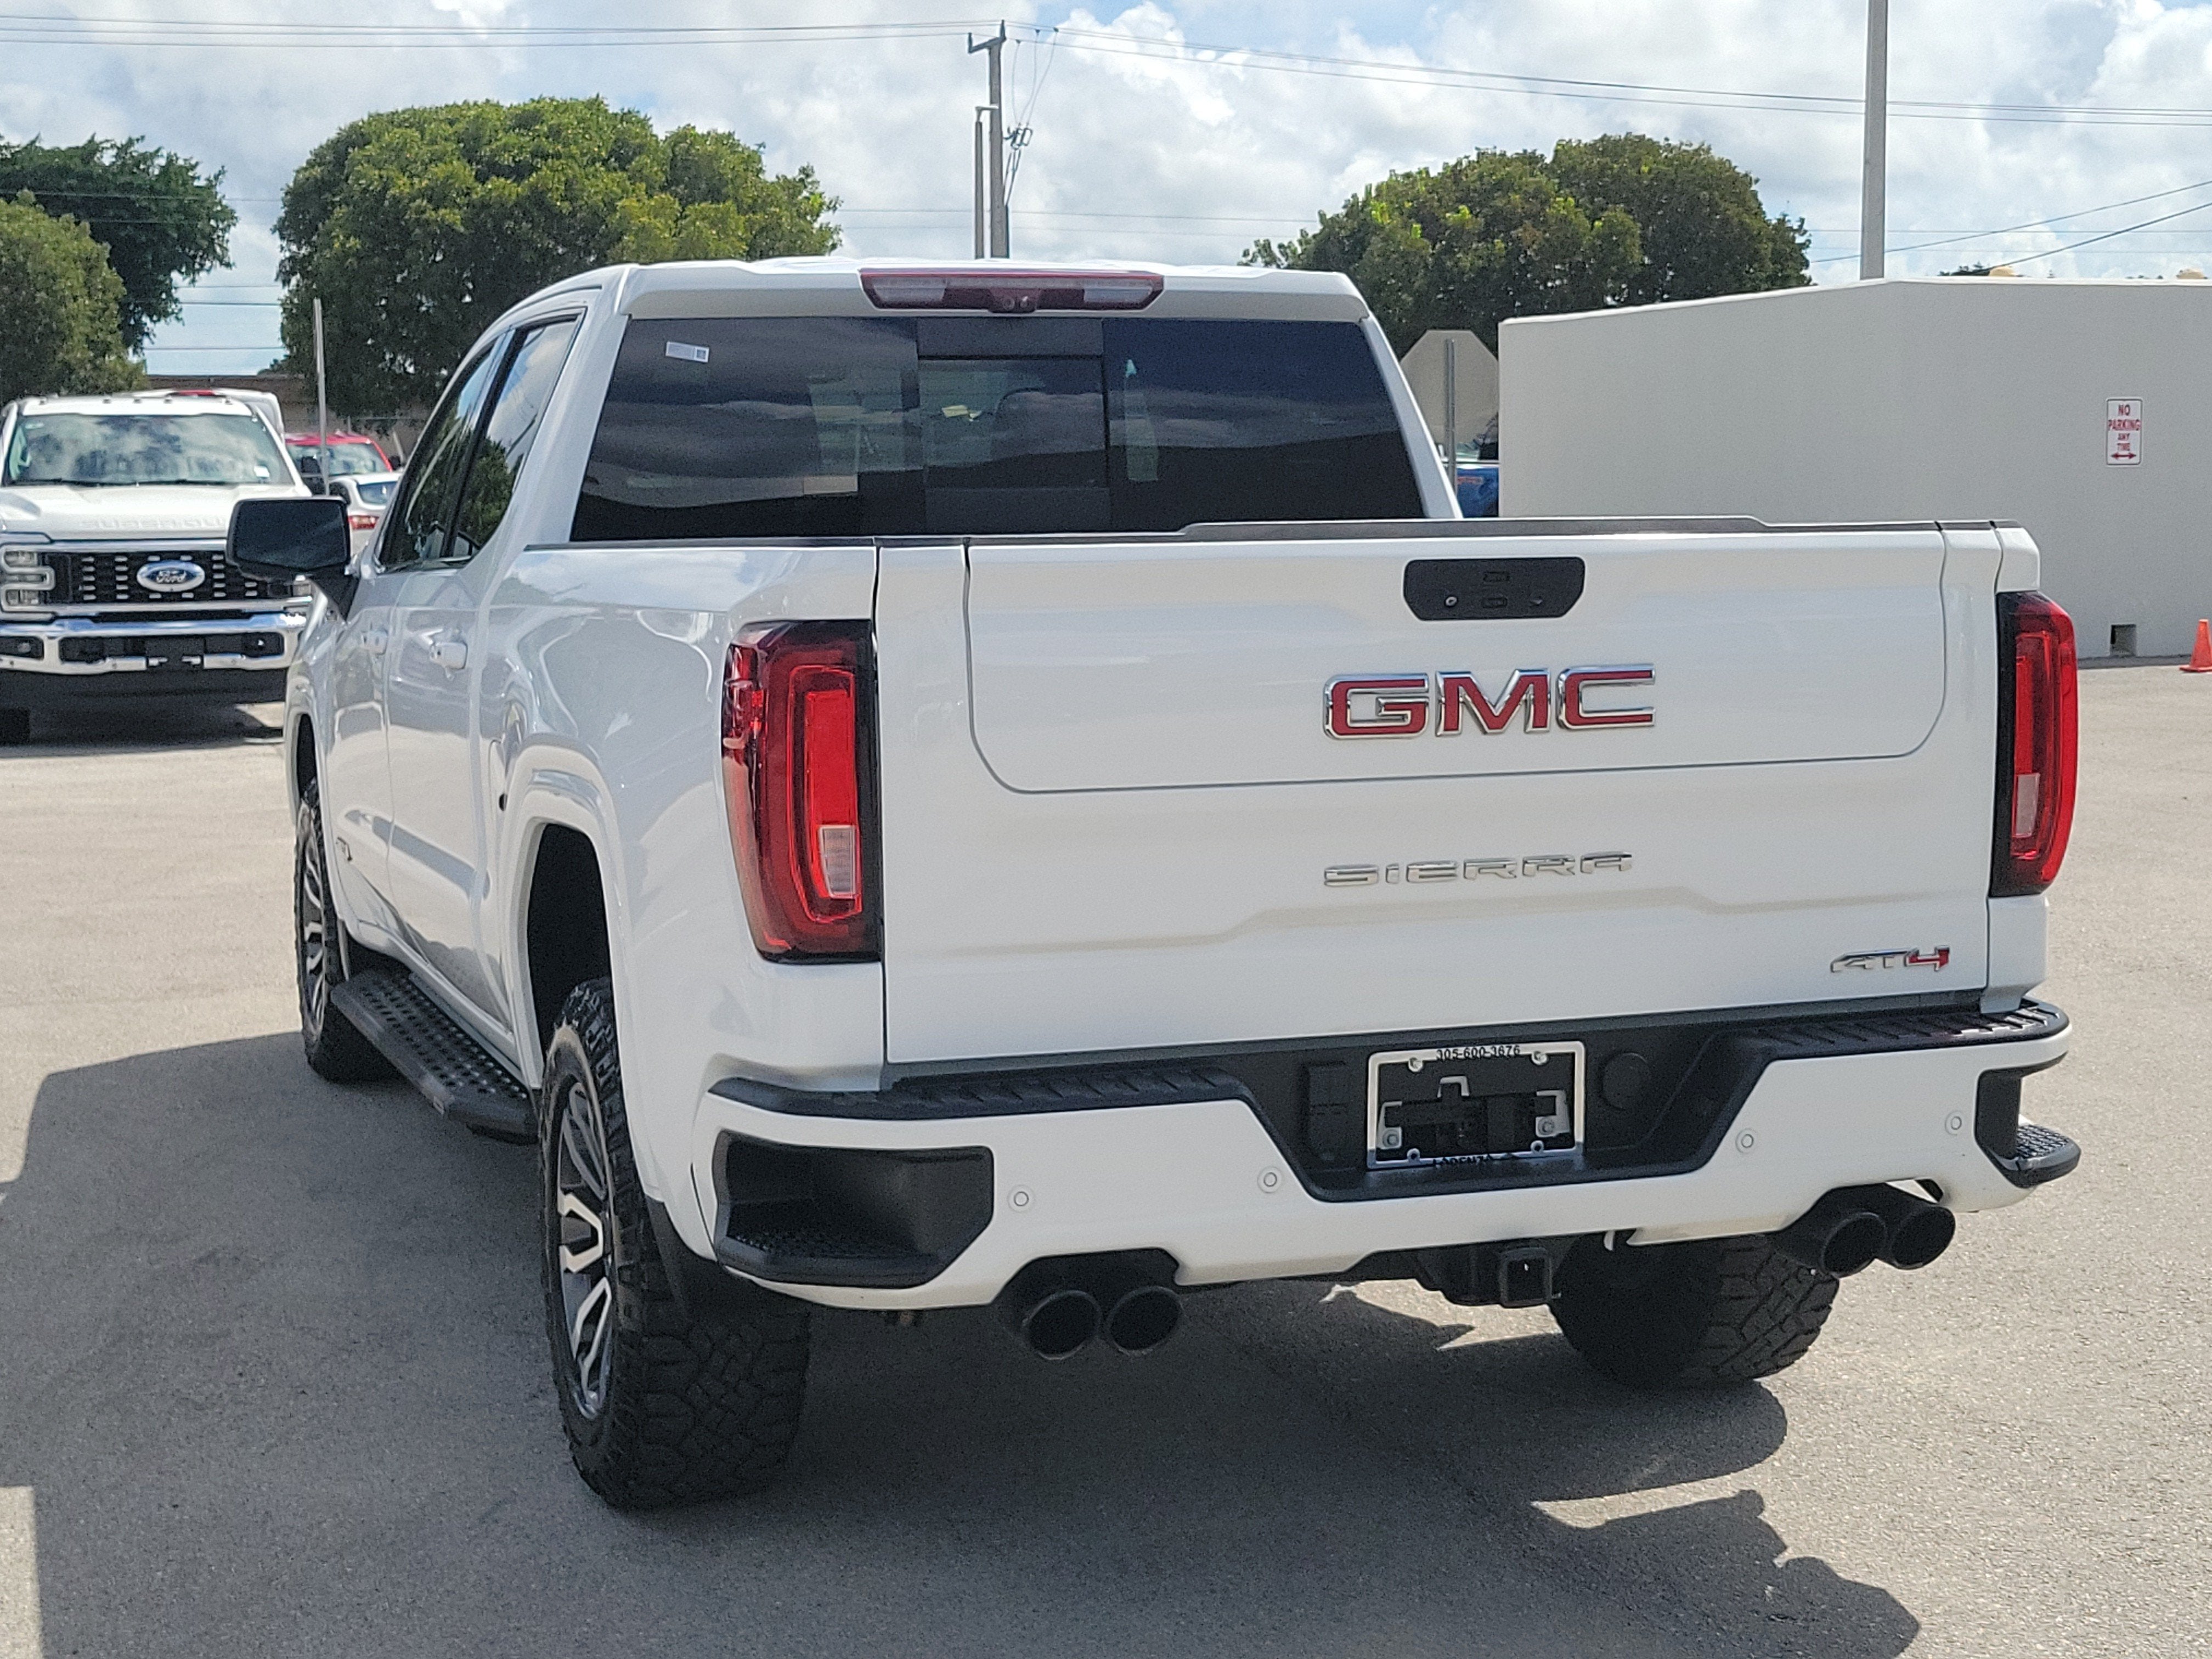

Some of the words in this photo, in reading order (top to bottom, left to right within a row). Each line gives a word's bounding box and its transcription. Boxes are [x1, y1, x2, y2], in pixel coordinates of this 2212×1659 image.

[2118, 404, 2131, 416] NO
[2107, 419, 2141, 431] PARKING
[2117, 443, 2130, 451] TIME
[156, 570, 187, 584] Ford
[1323, 664, 1655, 739] GMC
[1323, 850, 1633, 887] SIERRA
[1830, 945, 1950, 973] AT4
[1436, 1045, 1521, 1062] 305-600-3676
